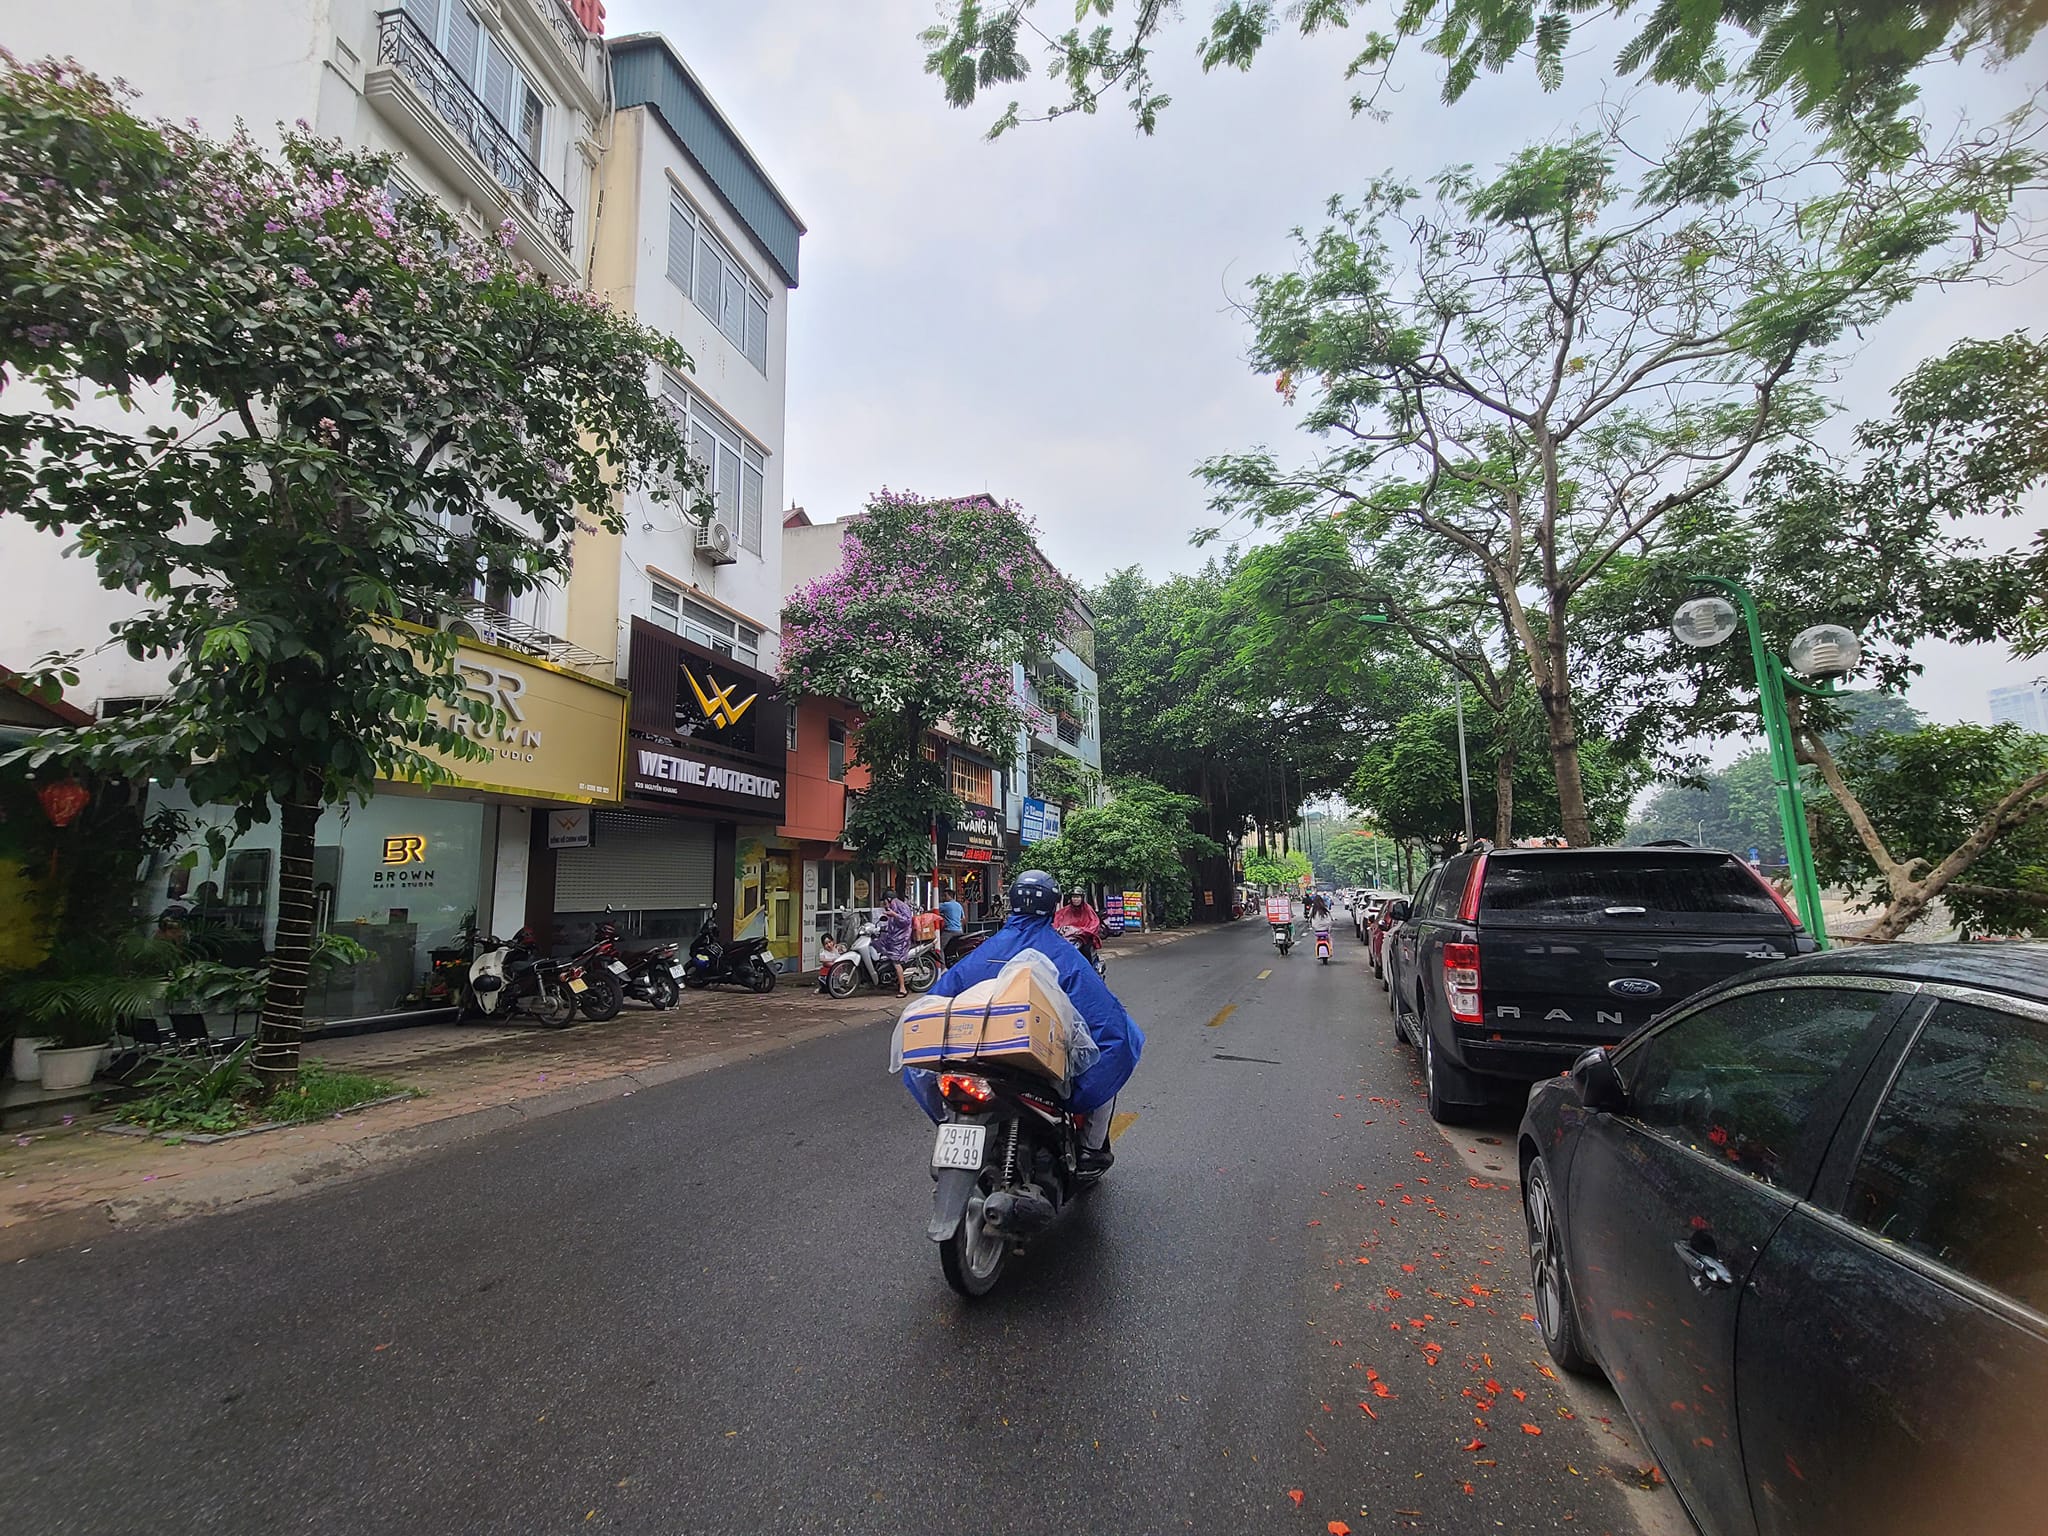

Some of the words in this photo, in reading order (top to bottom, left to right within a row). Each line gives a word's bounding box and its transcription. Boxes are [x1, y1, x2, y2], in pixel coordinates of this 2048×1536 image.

[638, 750, 706, 786] WETIME
[706, 766, 780, 800] AUTHENTIC
[382, 836, 424, 864] BR
[374, 870, 434, 881] BROWN
[1745, 951, 1786, 960] XLS
[1621, 981, 1650, 992] Ford
[1496, 1005, 1658, 1025] RAN
[943, 1128, 977, 1146] 29-H1
